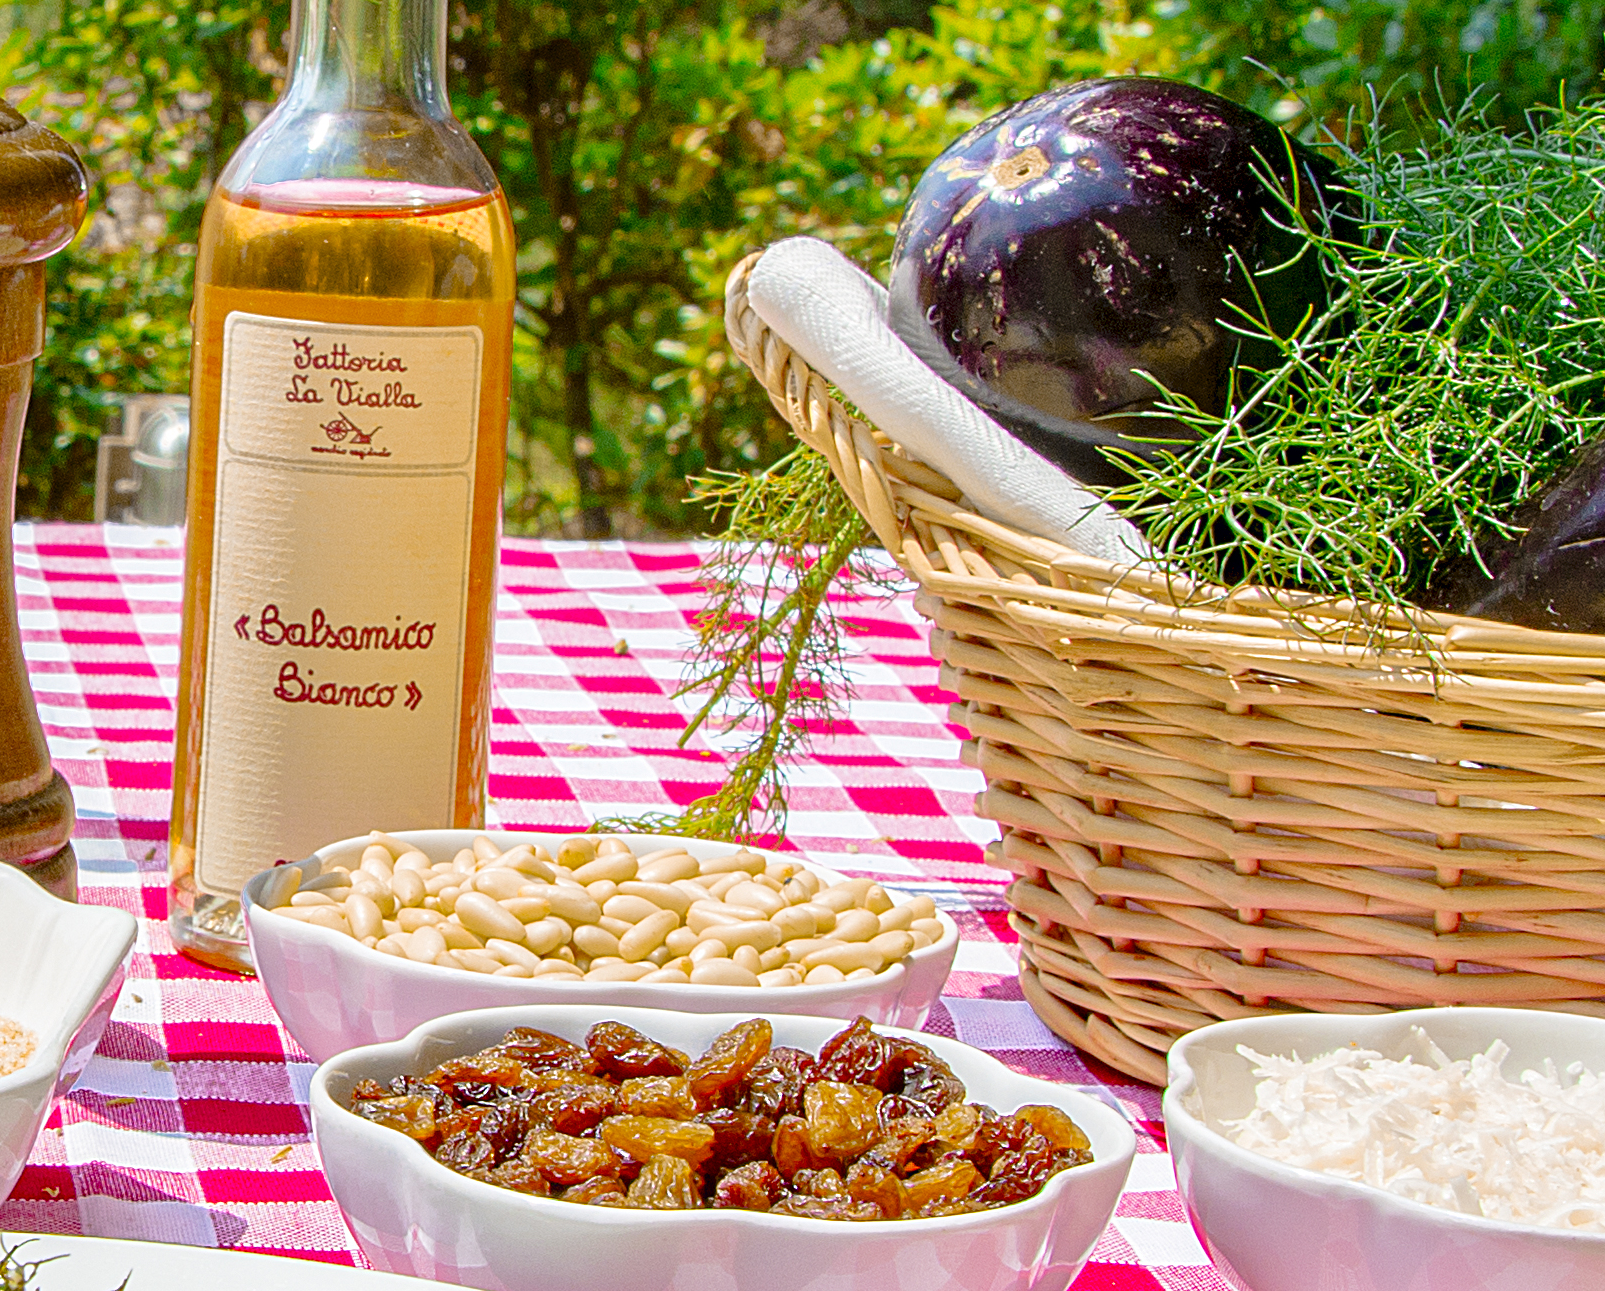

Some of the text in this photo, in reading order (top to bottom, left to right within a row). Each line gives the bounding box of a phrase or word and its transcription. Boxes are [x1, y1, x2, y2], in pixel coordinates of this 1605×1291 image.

[293, 336, 408, 372] Fattoria
[286, 374, 422, 409] La Vialla
